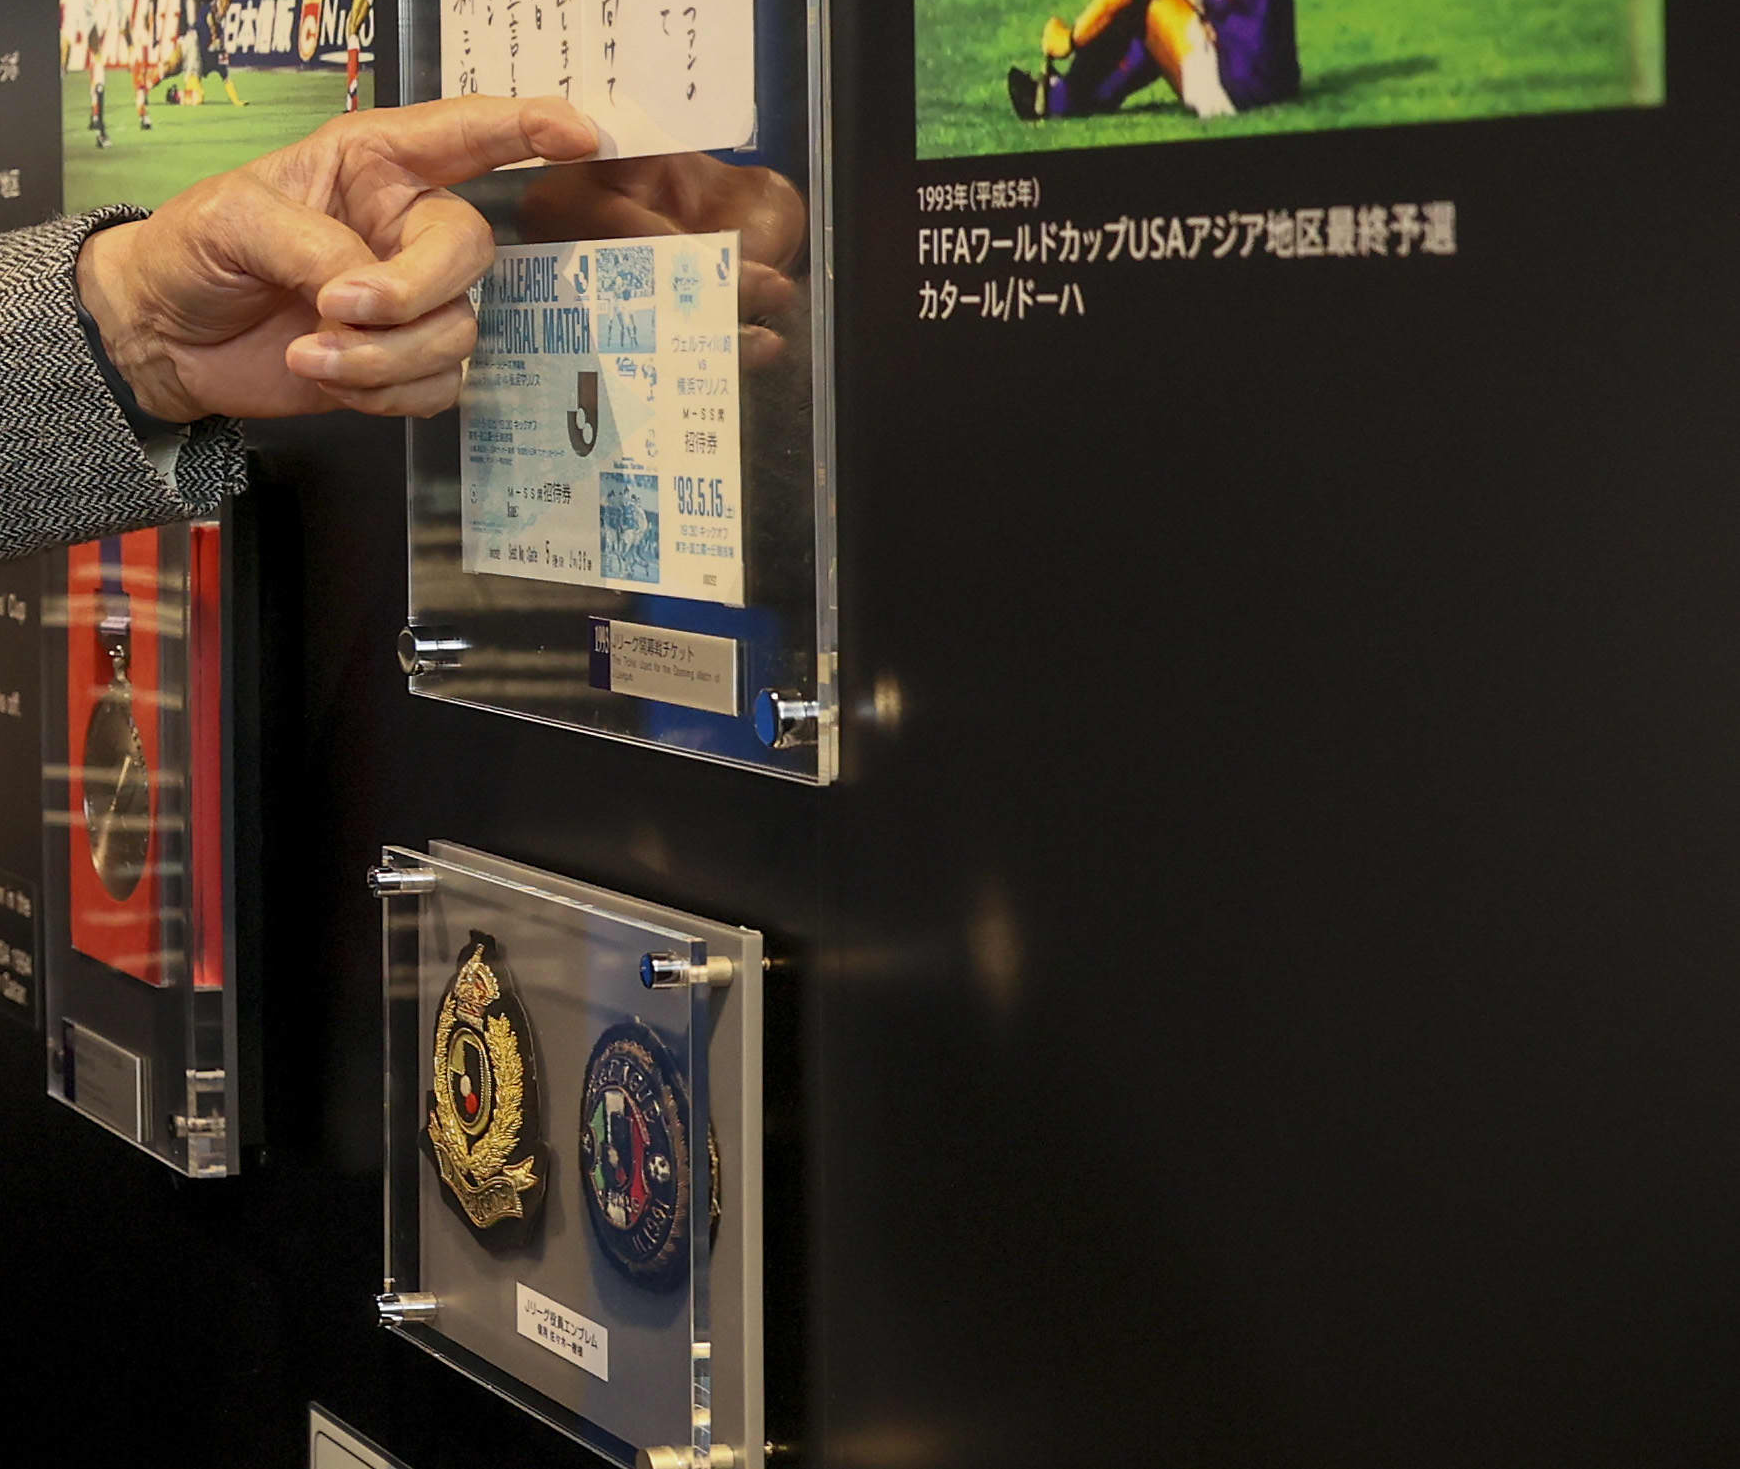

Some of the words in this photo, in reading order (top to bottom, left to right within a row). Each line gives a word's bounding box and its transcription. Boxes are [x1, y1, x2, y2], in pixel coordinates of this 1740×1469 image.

[916, 176, 1041, 212] 1993年(平成5年)
[917, 200, 1458, 267] FIFAワールドカップUSAアジア地区最終予選
[500, 255, 559, 303] J.LEAGUE
[917, 277, 1086, 322] カタール/ドーハ
[543, 307, 590, 355] MATCH
